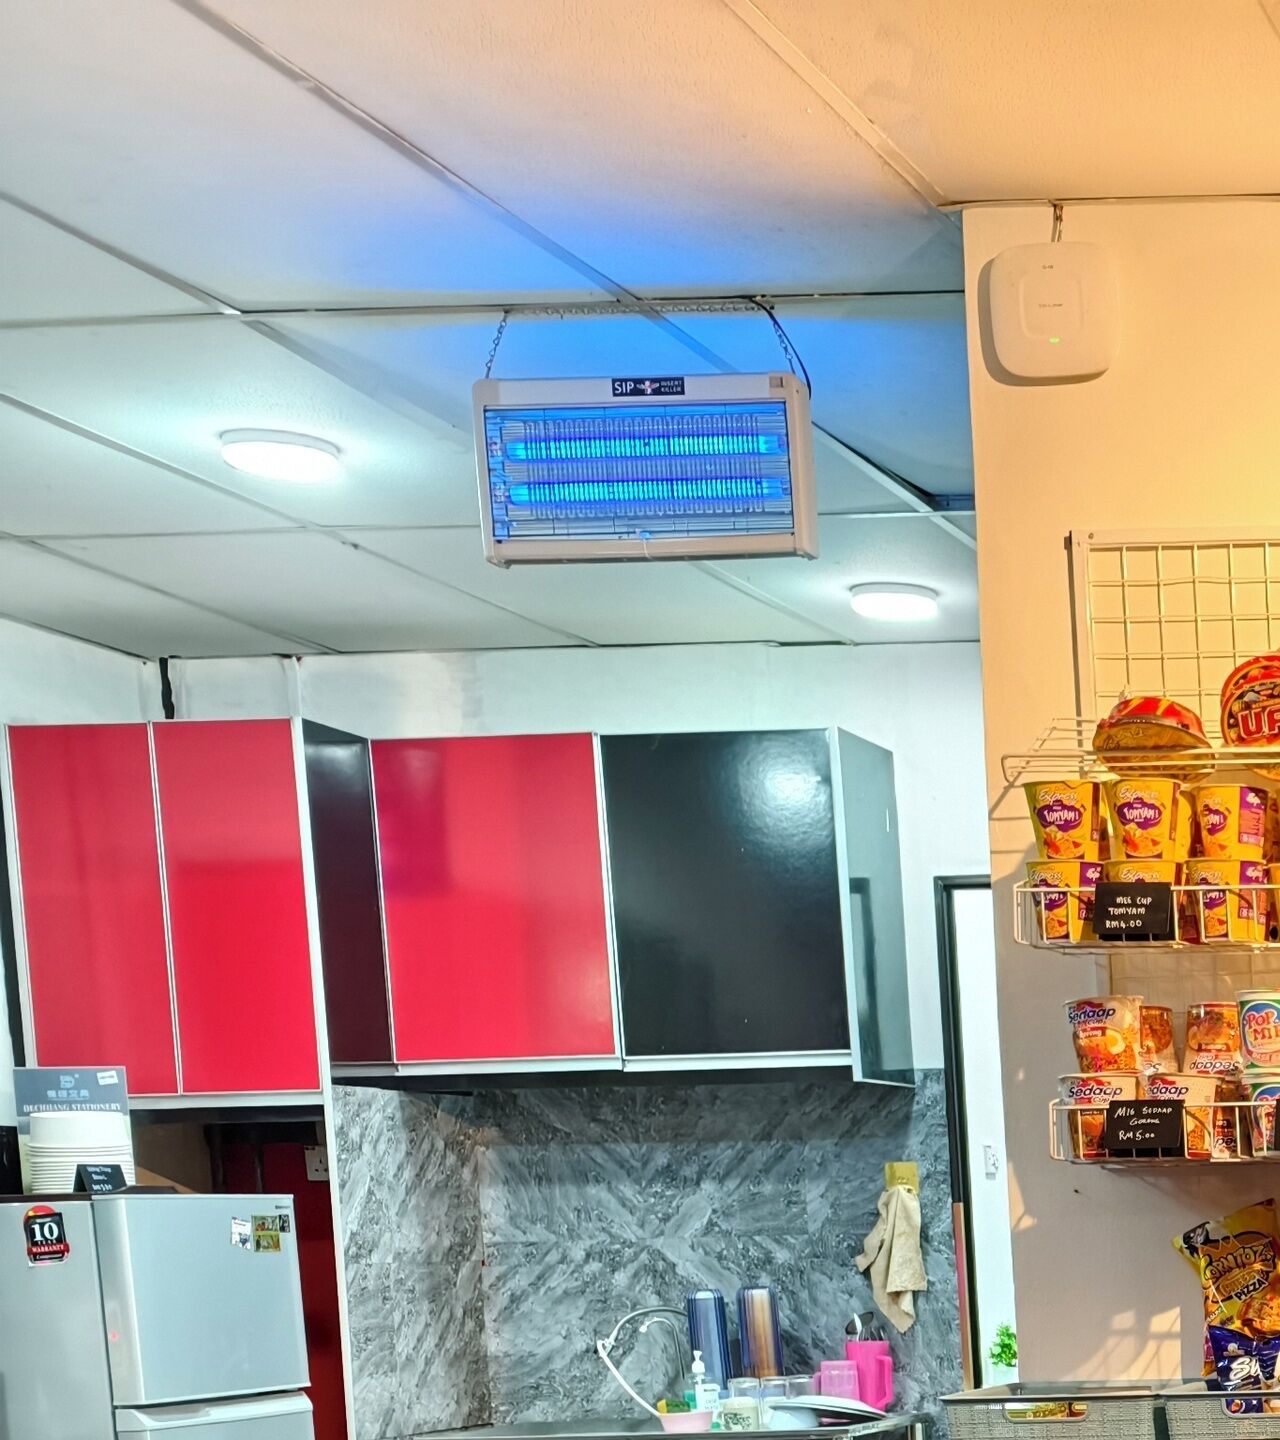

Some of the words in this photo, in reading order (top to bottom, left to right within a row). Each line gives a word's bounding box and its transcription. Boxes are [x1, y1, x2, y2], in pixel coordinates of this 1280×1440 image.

[615, 382, 634, 393] SIP
[1116, 896, 1132, 904] MEE
[1136, 896, 1152, 904] CUP
[1108, 907, 1145, 915] TOMYAM
[1245, 1010, 1275, 1030] POP
[1068, 1085, 1123, 1098] Sedaap
[72, 1103, 120, 1111] STATIONERY
[31, 1222, 59, 1242] 10
